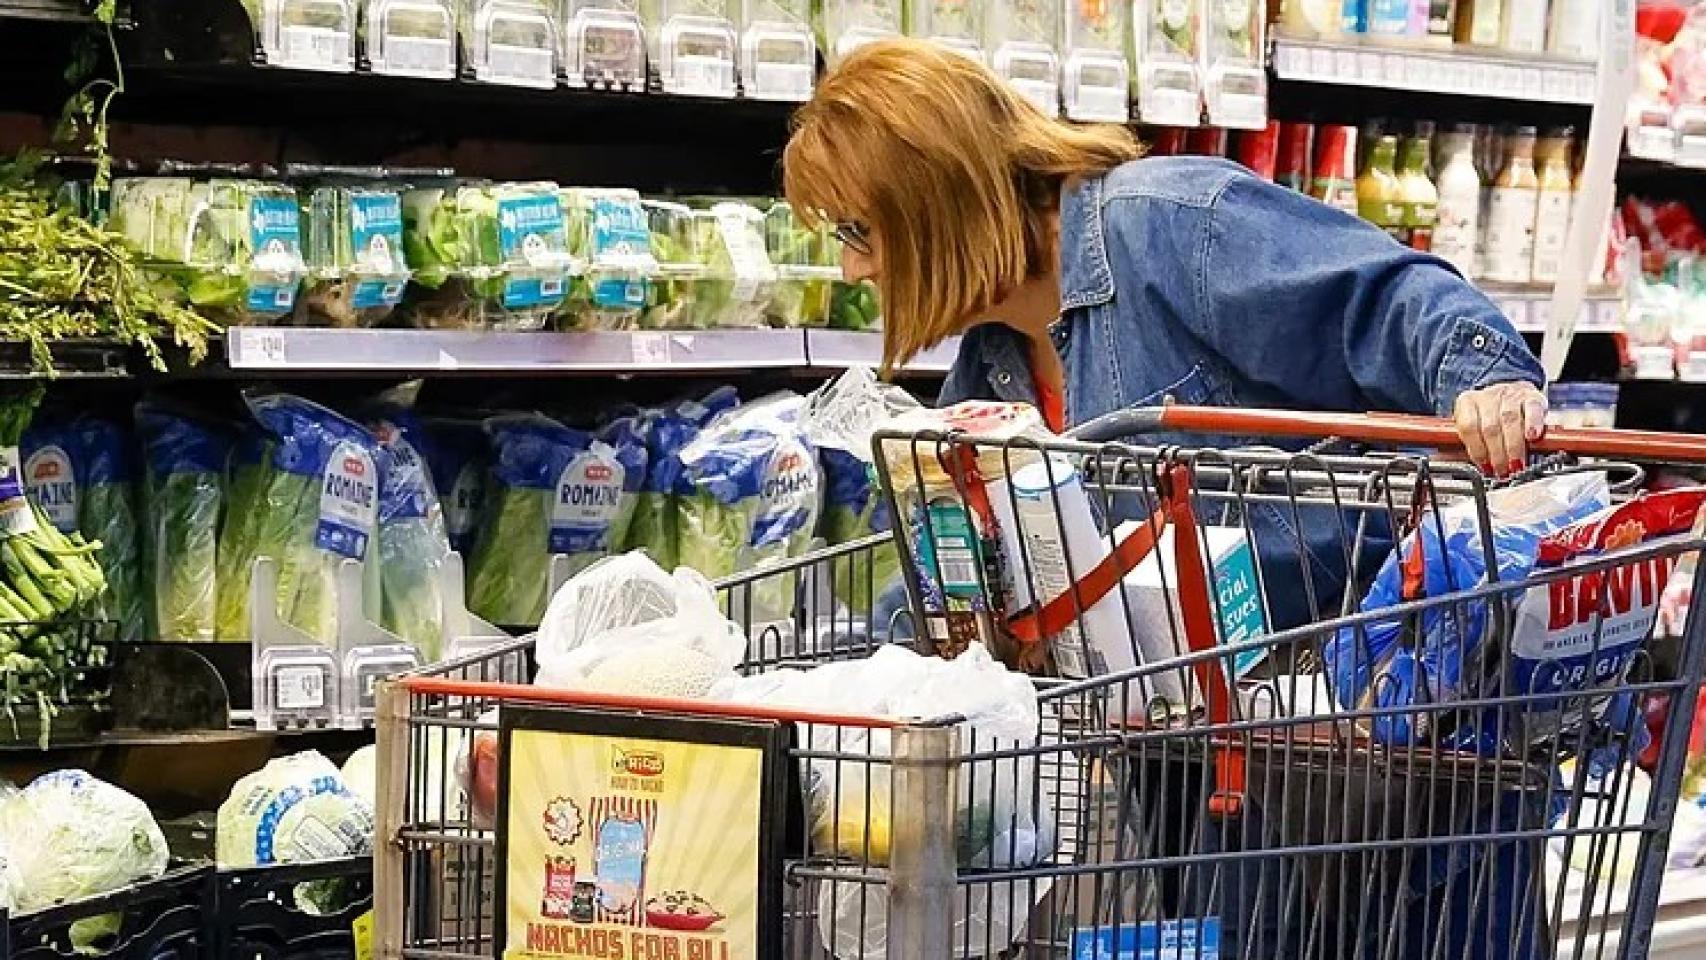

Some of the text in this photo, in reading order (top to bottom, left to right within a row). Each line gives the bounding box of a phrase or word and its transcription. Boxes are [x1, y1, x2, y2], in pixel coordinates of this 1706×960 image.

[1219, 569, 1249, 607] cial
[526, 922, 624, 960] NACHOS
[631, 932, 680, 960] FOR
